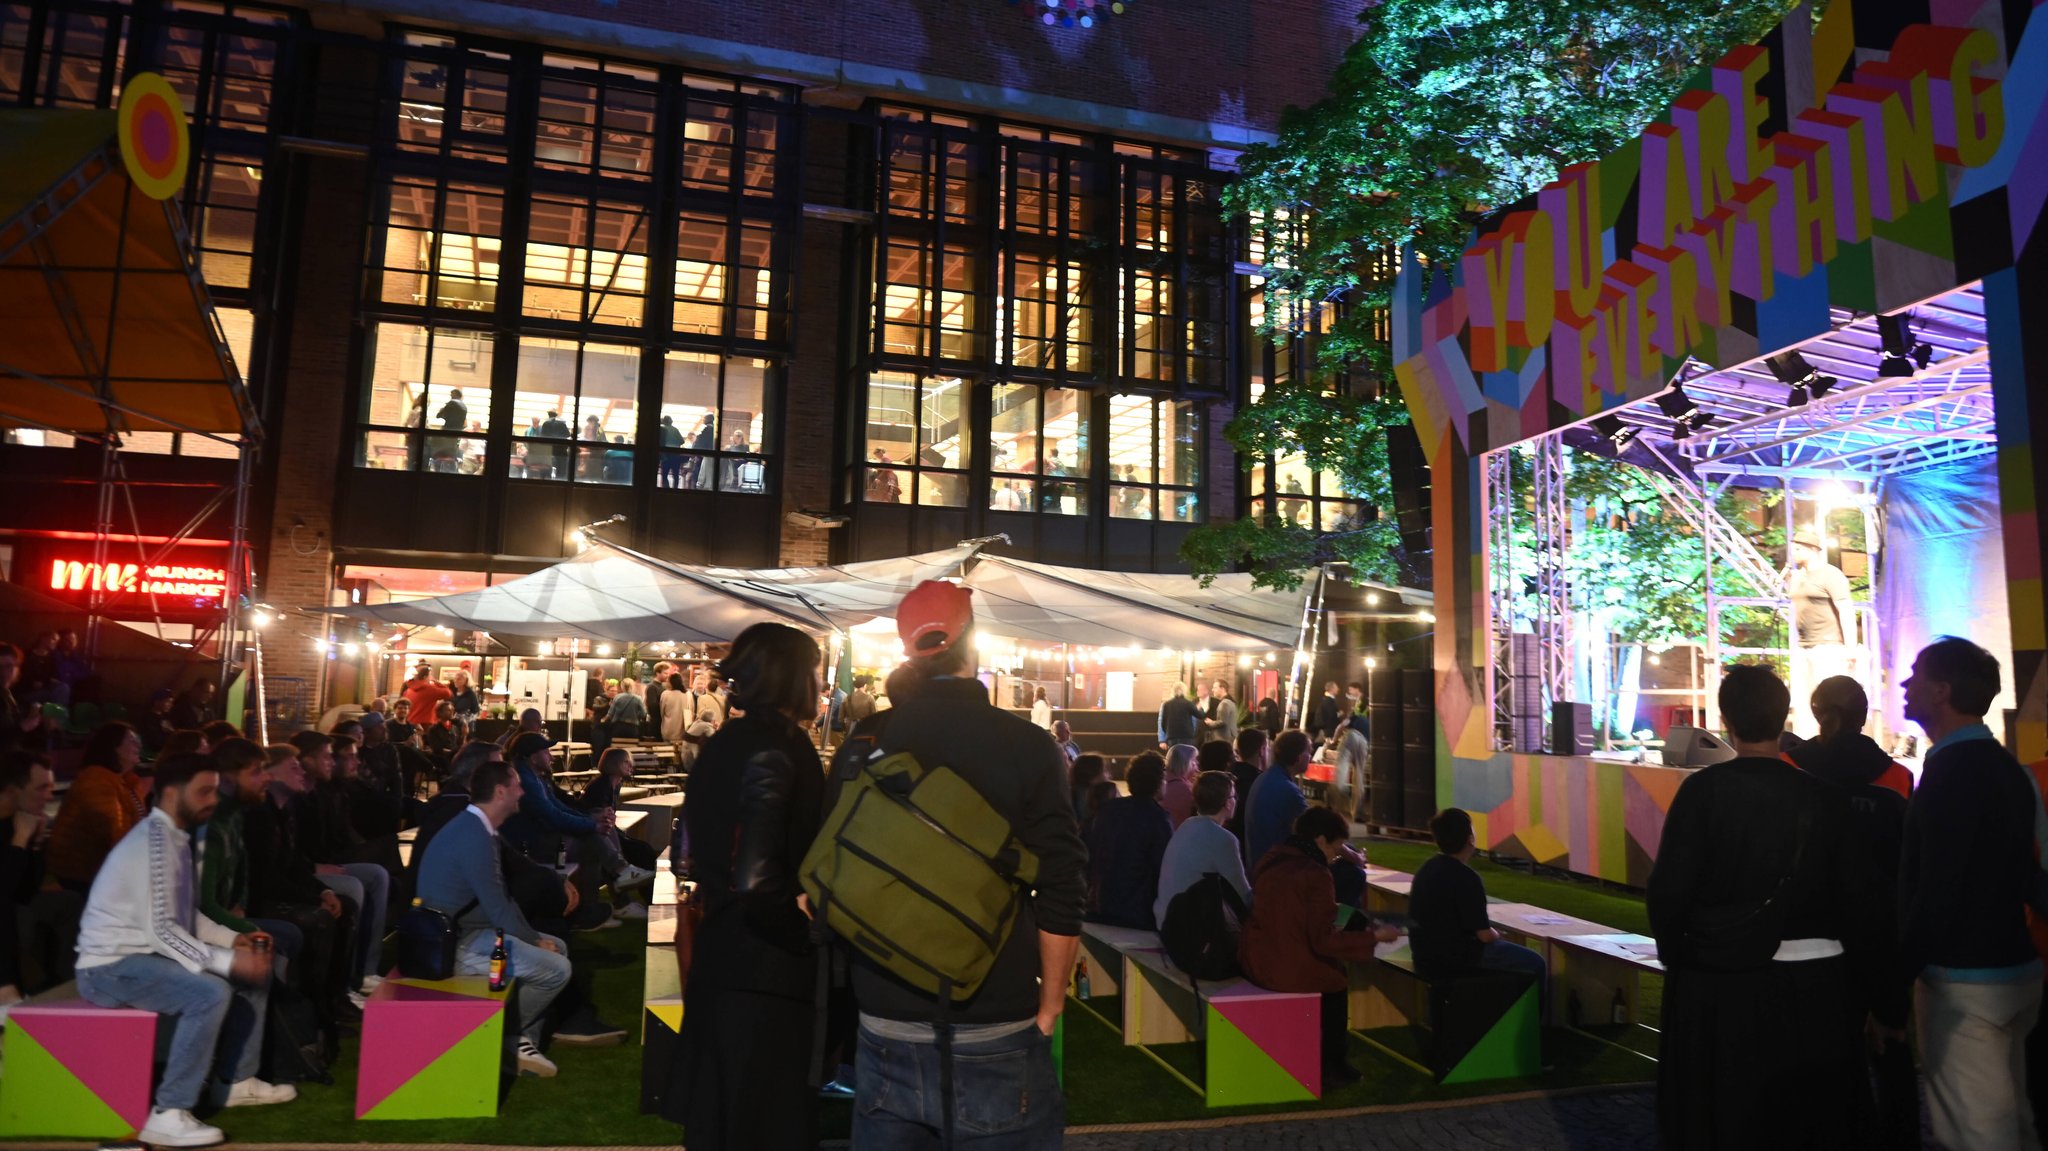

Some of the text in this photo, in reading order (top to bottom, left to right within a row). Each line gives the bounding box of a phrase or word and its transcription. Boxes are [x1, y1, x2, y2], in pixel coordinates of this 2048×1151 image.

[1480, 46, 1776, 373] YOU ARE
[1574, 29, 2005, 418] EVERYTHING
